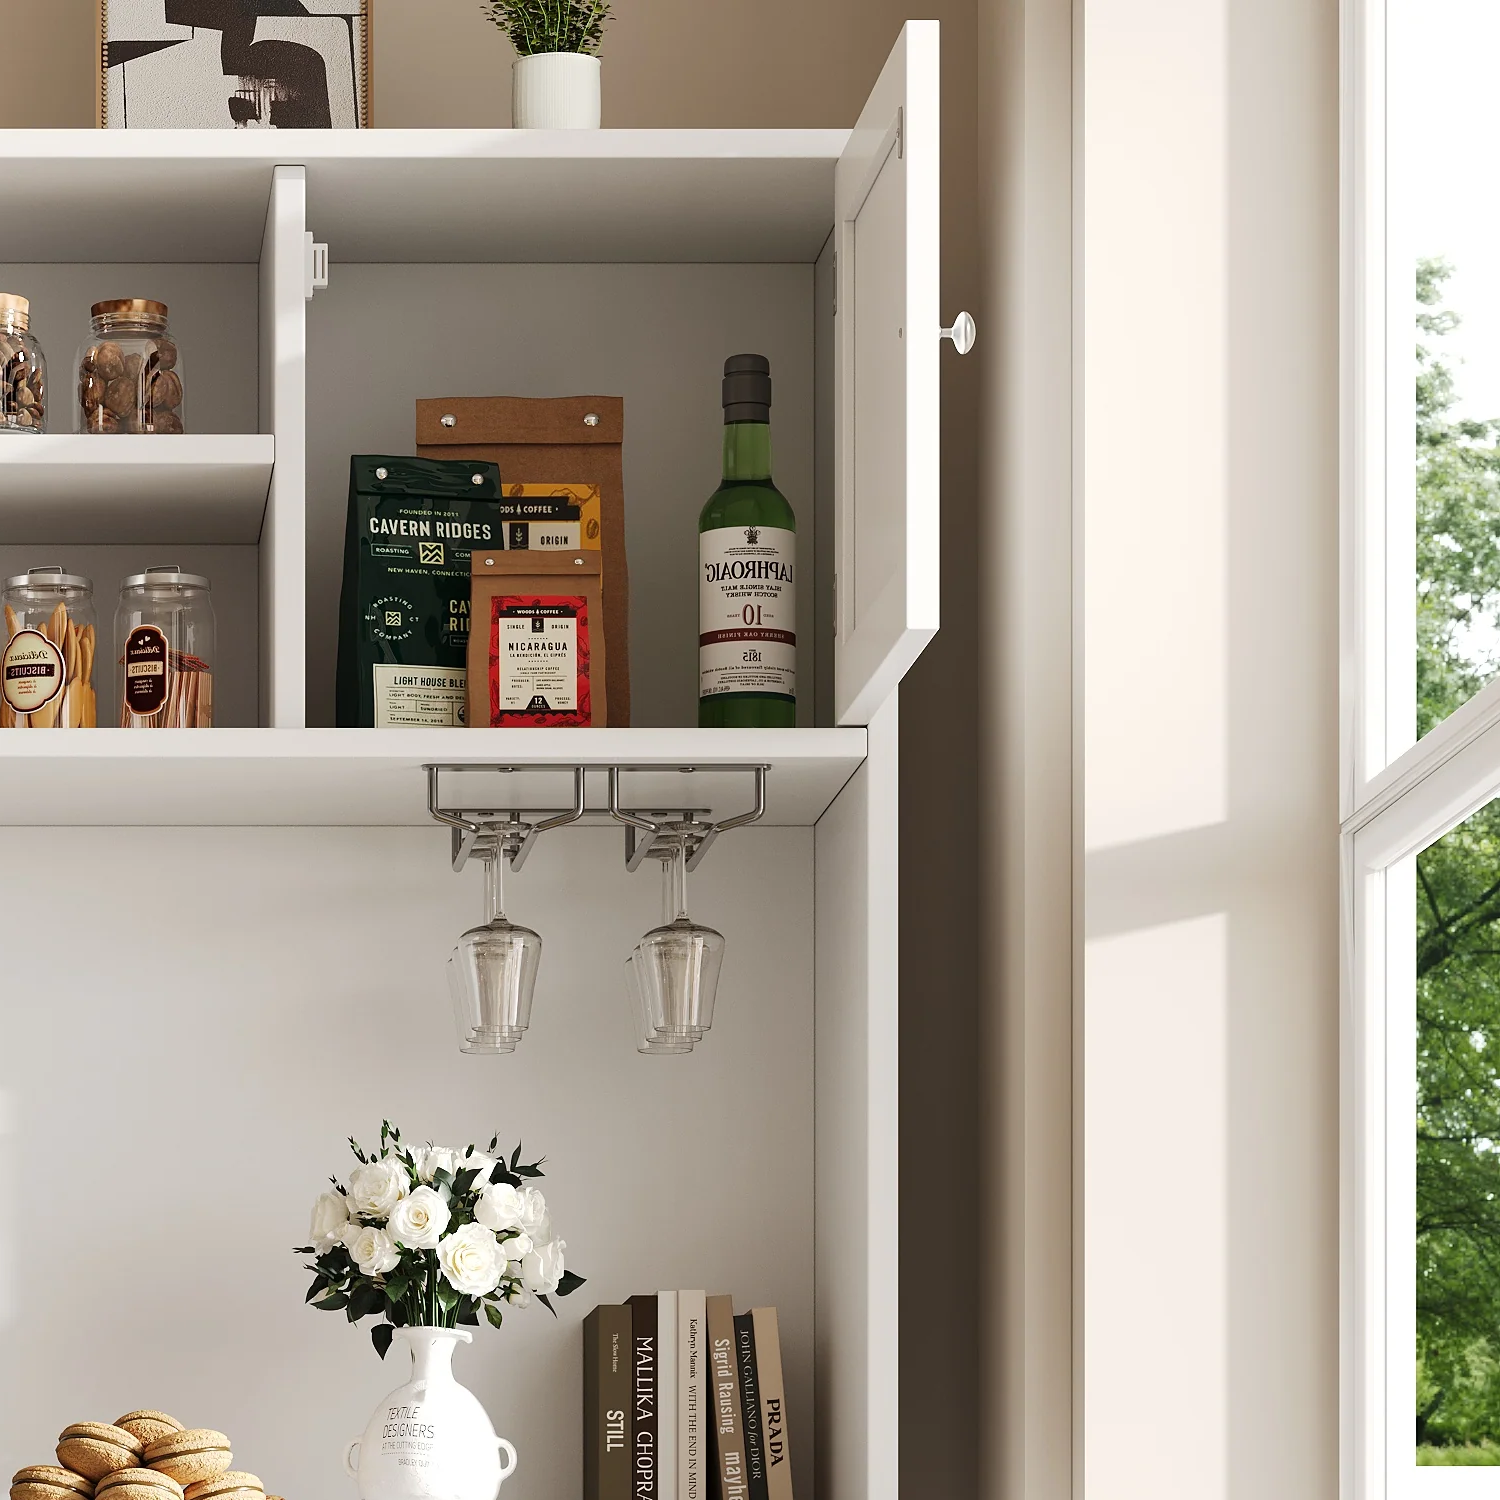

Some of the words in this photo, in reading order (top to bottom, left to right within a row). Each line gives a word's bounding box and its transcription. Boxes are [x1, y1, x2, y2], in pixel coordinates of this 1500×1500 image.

[523, 506, 552, 514] COFFEE
[369, 517, 430, 537] CAVERN
[436, 521, 492, 540] RIDGES
[375, 547, 410, 555] ROASTING
[540, 536, 569, 545] ORIGIN
[373, 628, 413, 641] COMPANY
[508, 642, 568, 651] NICARAGUA
[394, 676, 418, 686] LIGHT
[420, 677, 446, 688] HOUSE
[534, 696, 543, 705] 12
[688, 1318, 698, 1350] Kathryn
[739, 1329, 752, 1364] JOHN
[689, 1350, 698, 1379] Mannix
[713, 1338, 734, 1378] Sigrid
[636, 1337, 654, 1421] MALLIKA
[688, 1385, 697, 1409] WITH
[742, 1364, 758, 1430] GALLIANO
[386, 1406, 421, 1420] TEXTILE
[718, 1382, 738, 1436] Rausing
[382, 1423, 435, 1438] DESIGNERS
[606, 1410, 624, 1452] STILL
[688, 1412, 697, 1434] THE
[766, 1398, 784, 1467] PRADA
[688, 1436, 697, 1457] END
[748, 1430, 759, 1446] for
[688, 1459, 697, 1469] IN
[750, 1448, 762, 1480] DIOR
[688, 1472, 697, 1500] MIND
